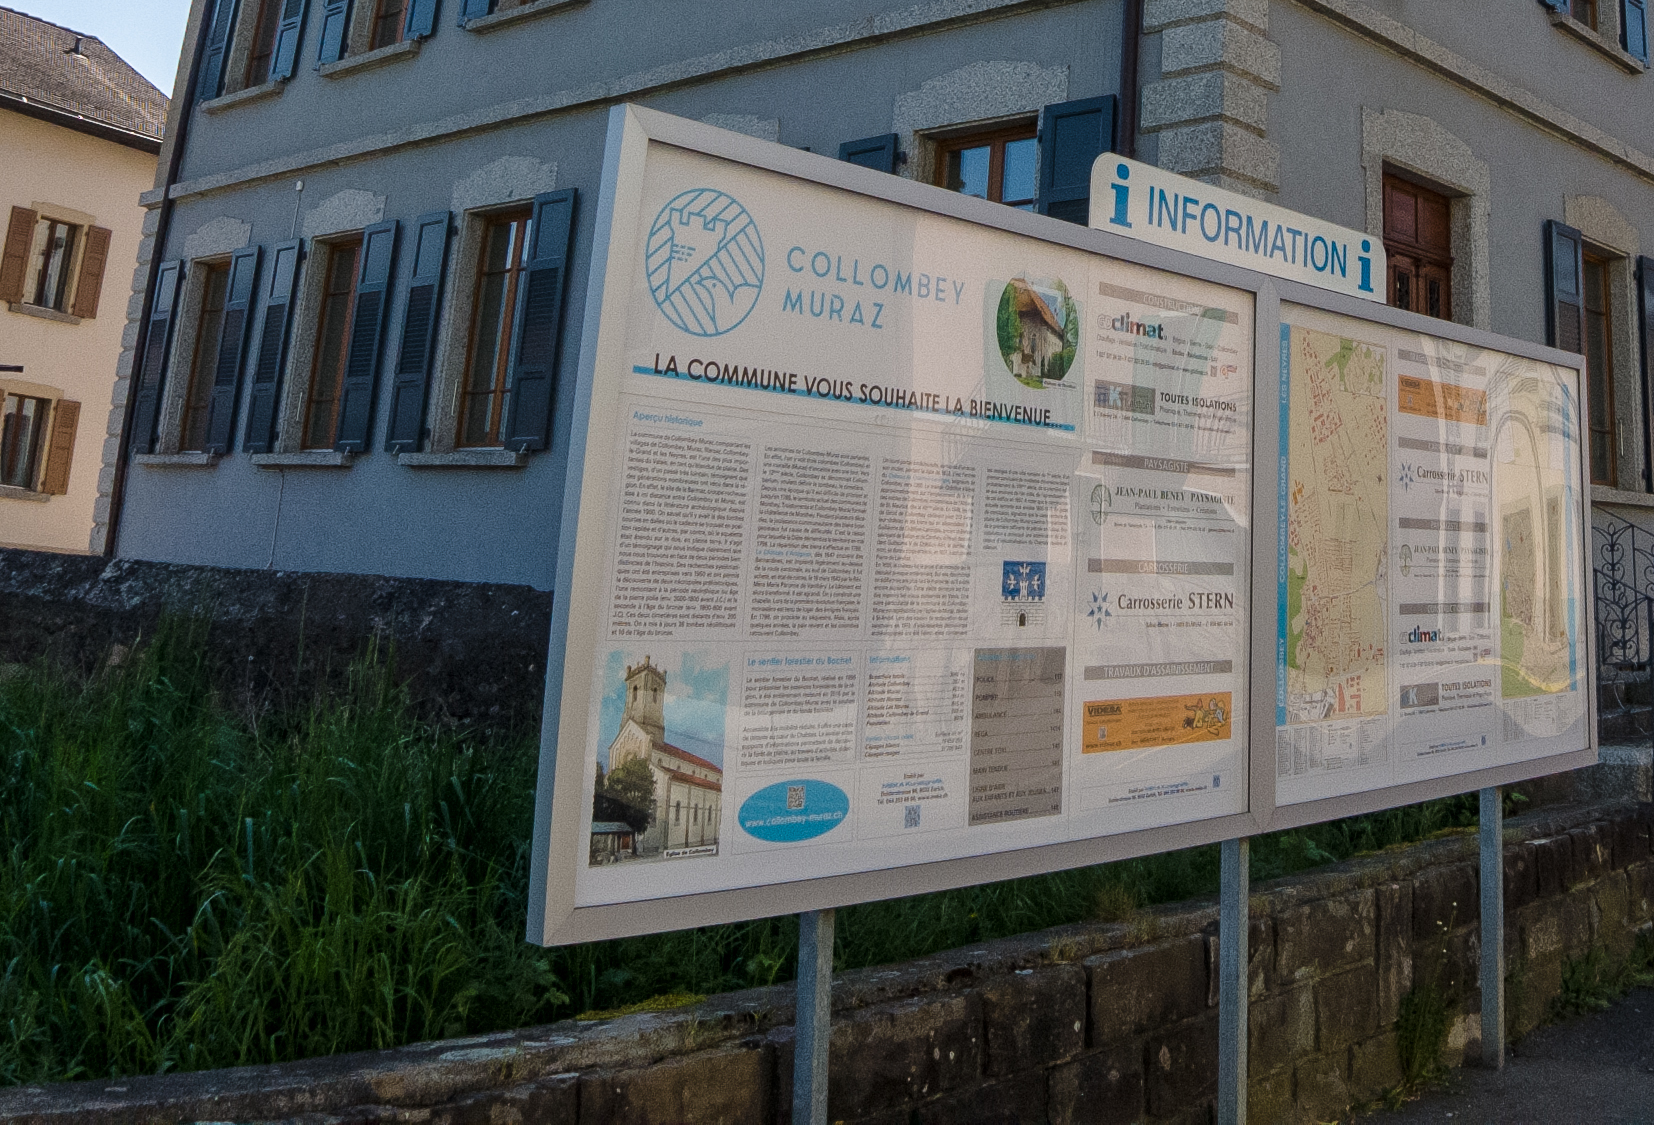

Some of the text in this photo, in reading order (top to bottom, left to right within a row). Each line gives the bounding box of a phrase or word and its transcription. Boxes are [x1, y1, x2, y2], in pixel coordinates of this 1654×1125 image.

[1147, 185, 1347, 279] INFORMATION
[787, 245, 966, 305] COLLOMBEY
[782, 287, 884, 330] MURAZ
[652, 352, 680, 377] LA
[686, 358, 799, 394] COMMUNE
[804, 376, 855, 401] VOUS
[858, 383, 940, 413] SOUHAITE
[944, 393, 965, 415] LA
[1160, 392, 1190, 405] TOUTES
[1191, 396, 1237, 413] ISOLATIONS
[633, 411, 704, 427] Aperçu historique
[1144, 458, 1189, 473] PAYSAGISTE
[1459, 469, 1489, 485] STERN
[1115, 486, 1159, 498] JEAN-PAUL
[1160, 491, 1185, 502] BENEY
[1138, 563, 1189, 574] CARROSSERIE
[1118, 592, 1234, 611] Carrosserie STERN
[1103, 665, 1141, 678] TRAVAUX
